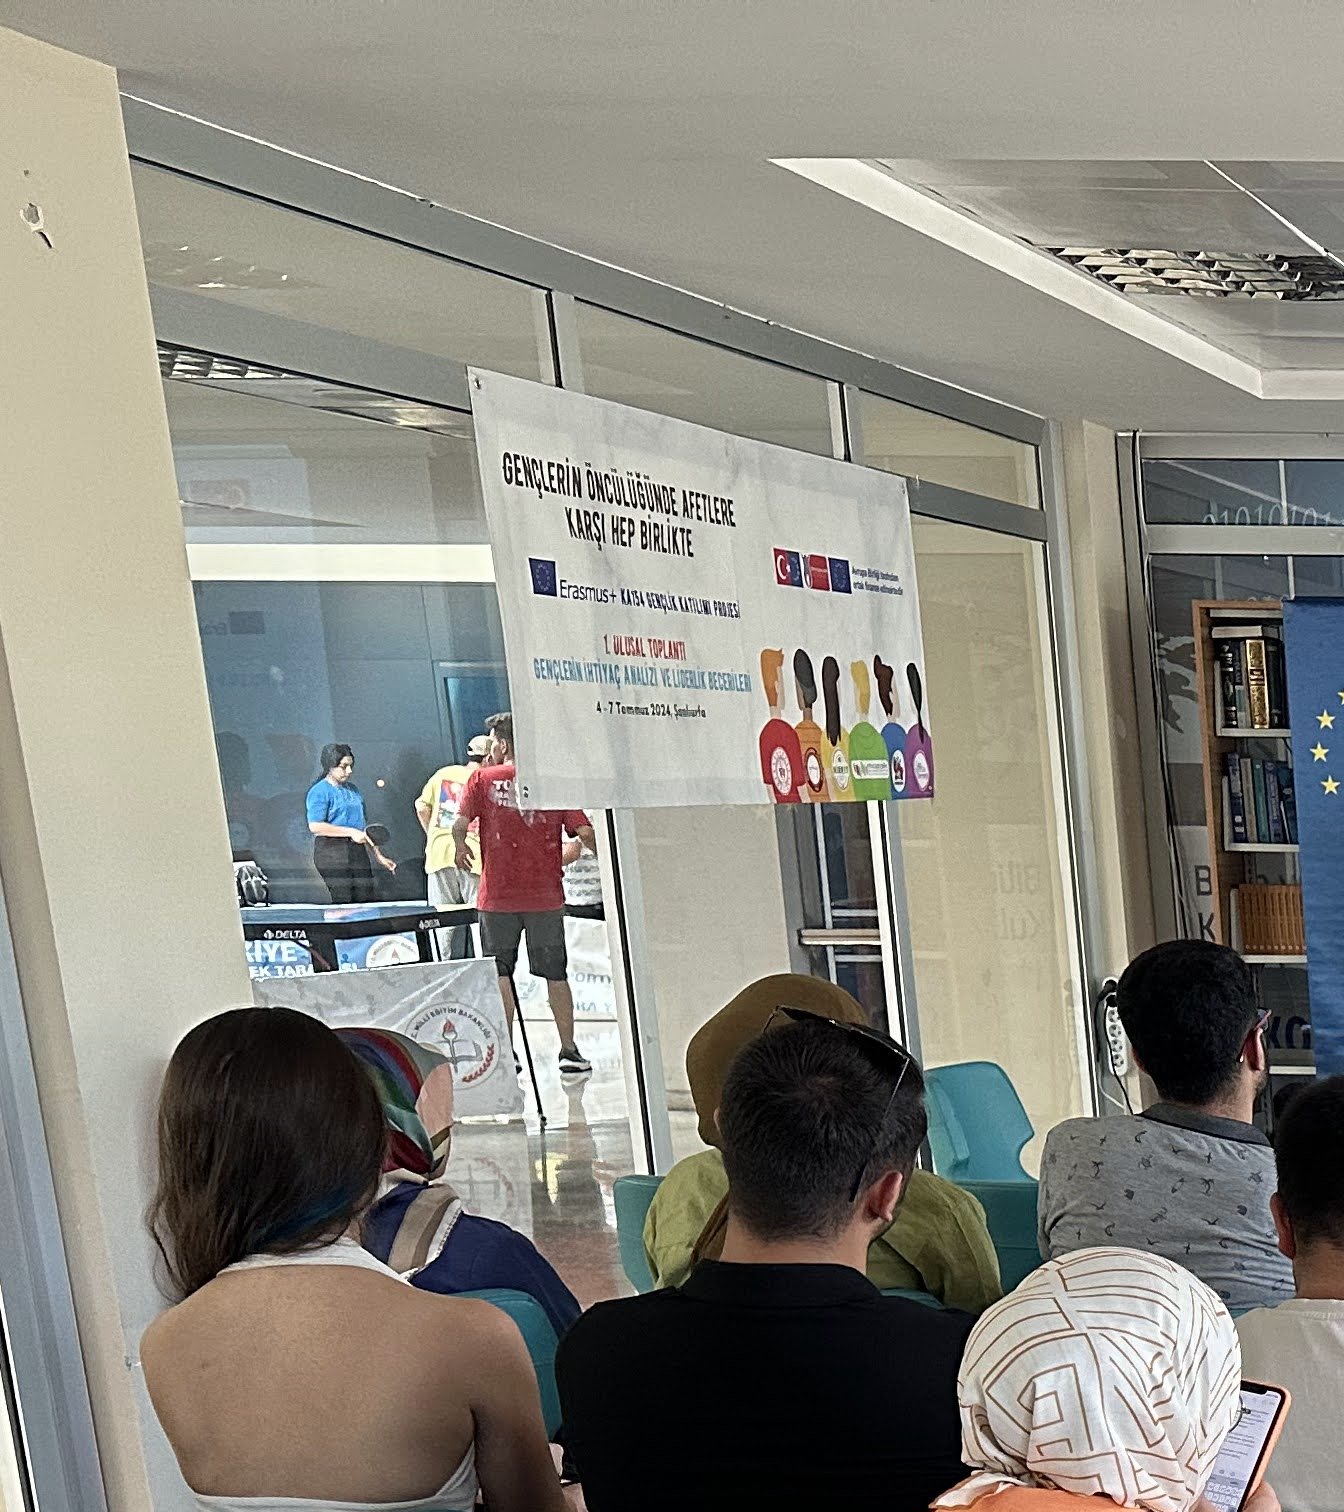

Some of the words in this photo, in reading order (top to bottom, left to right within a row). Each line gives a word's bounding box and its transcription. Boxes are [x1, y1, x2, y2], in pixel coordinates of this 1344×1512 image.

[502, 451, 583, 499] GENÇLERİN
[585, 462, 678, 517] ÖNCÜLÜĞÜNDE
[682, 489, 736, 527] AFETLERE
[565, 506, 606, 551] KARŞI
[611, 514, 635, 547] HEP
[640, 514, 694, 557] BİRLİKTE
[613, 634, 646, 658] ULUSAL
[647, 638, 687, 661] TOPLANTI
[275, 930, 308, 939] DELTA
